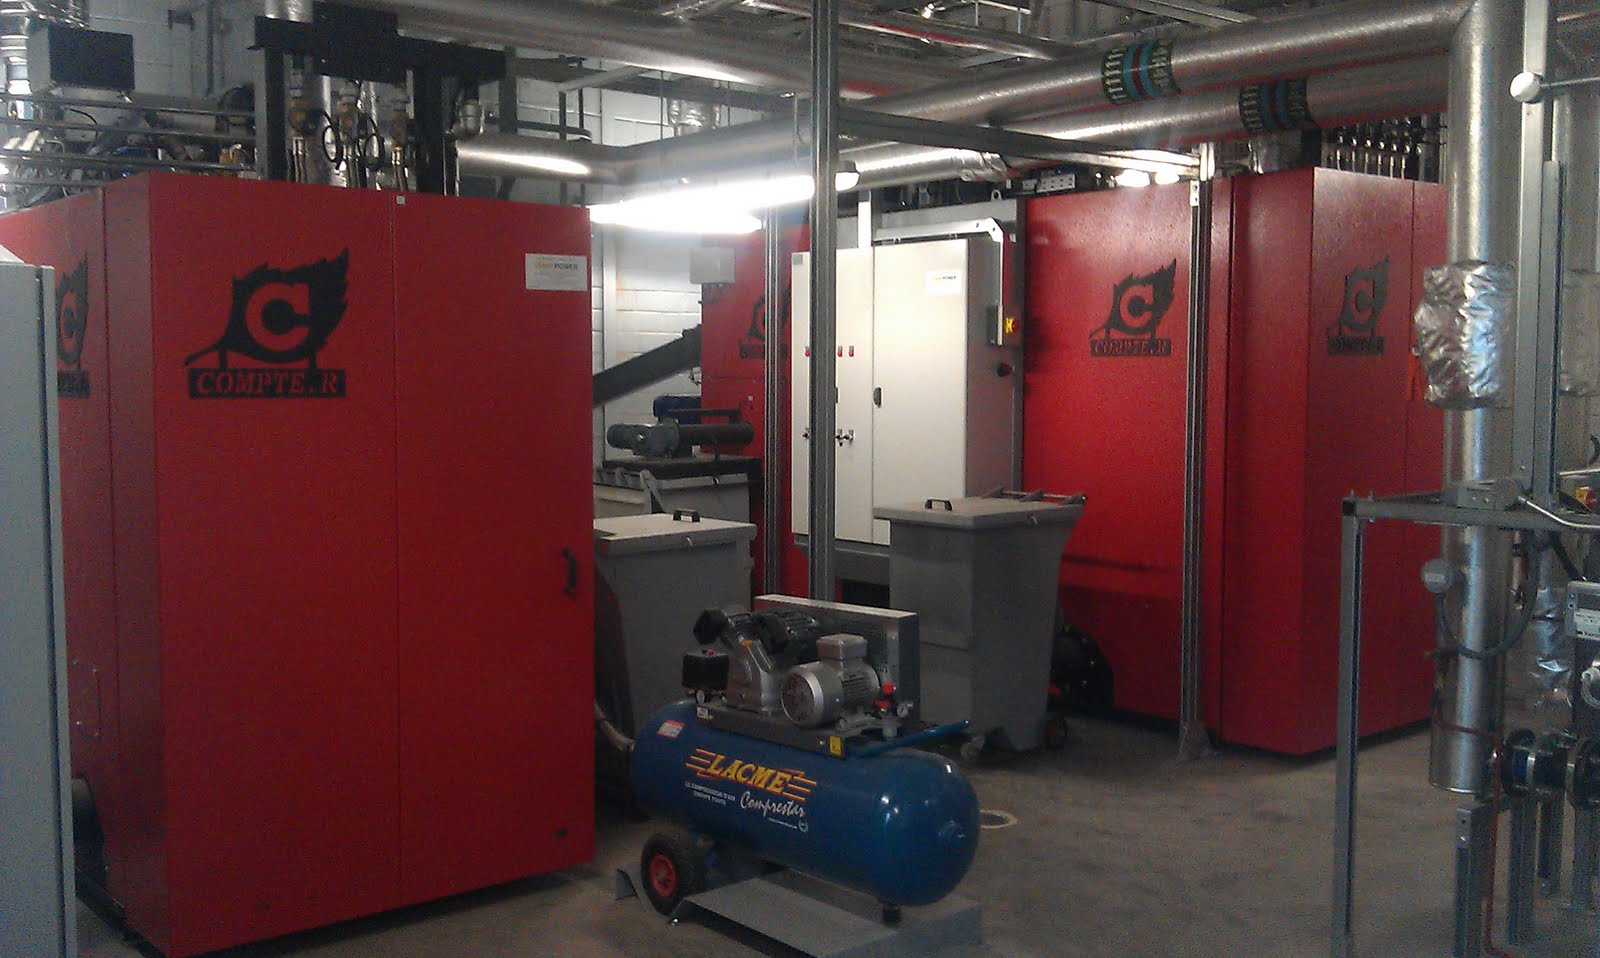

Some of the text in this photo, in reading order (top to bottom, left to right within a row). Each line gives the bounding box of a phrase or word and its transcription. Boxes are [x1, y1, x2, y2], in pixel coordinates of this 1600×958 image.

[246, 282, 311, 351] C
[1120, 284, 1154, 328] C
[1351, 280, 1374, 323] C
[708, 754, 791, 793] LACME
[740, 791, 806, 818] Comprestar
